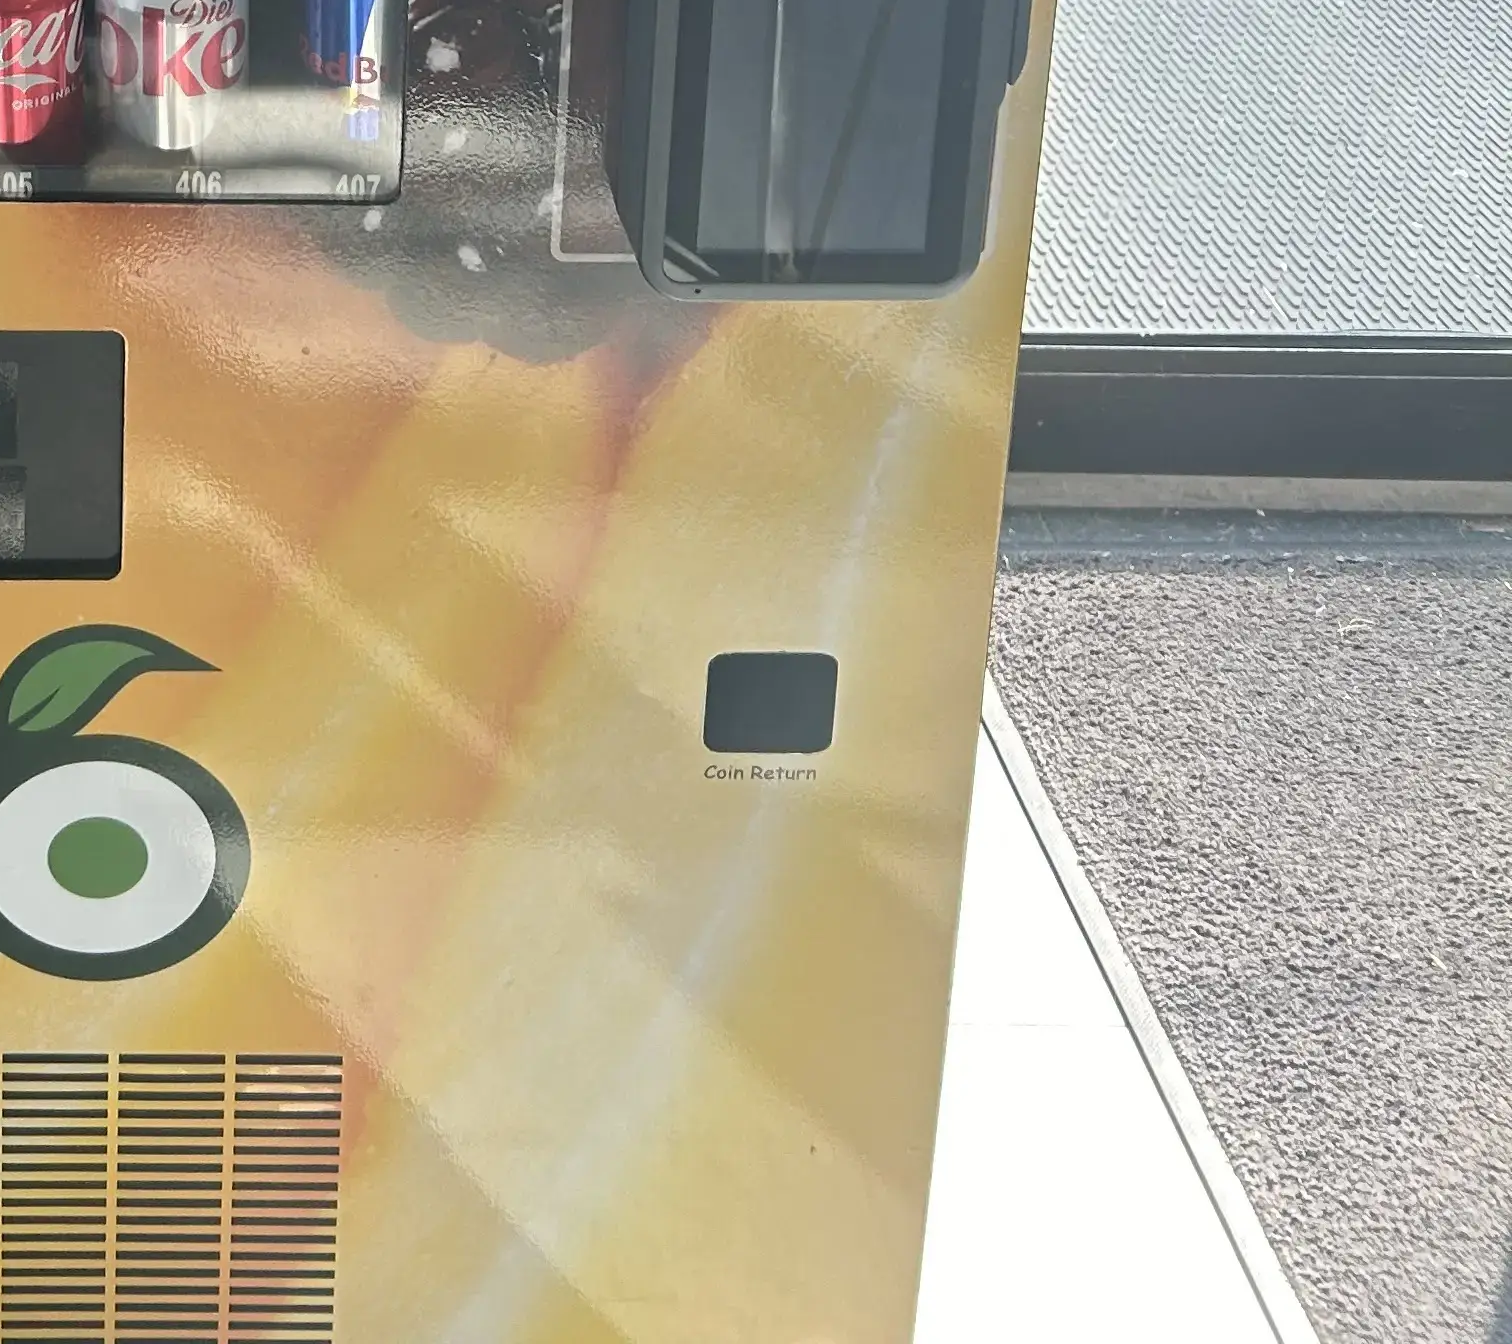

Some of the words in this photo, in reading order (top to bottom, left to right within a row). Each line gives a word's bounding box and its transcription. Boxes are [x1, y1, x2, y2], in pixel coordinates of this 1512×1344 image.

[11, 83, 78, 112] ORIGINAL
[175, 170, 223, 196] 406
[335, 173, 381, 198] 407
[703, 764, 745, 781] Coin
[749, 764, 818, 781] Return
